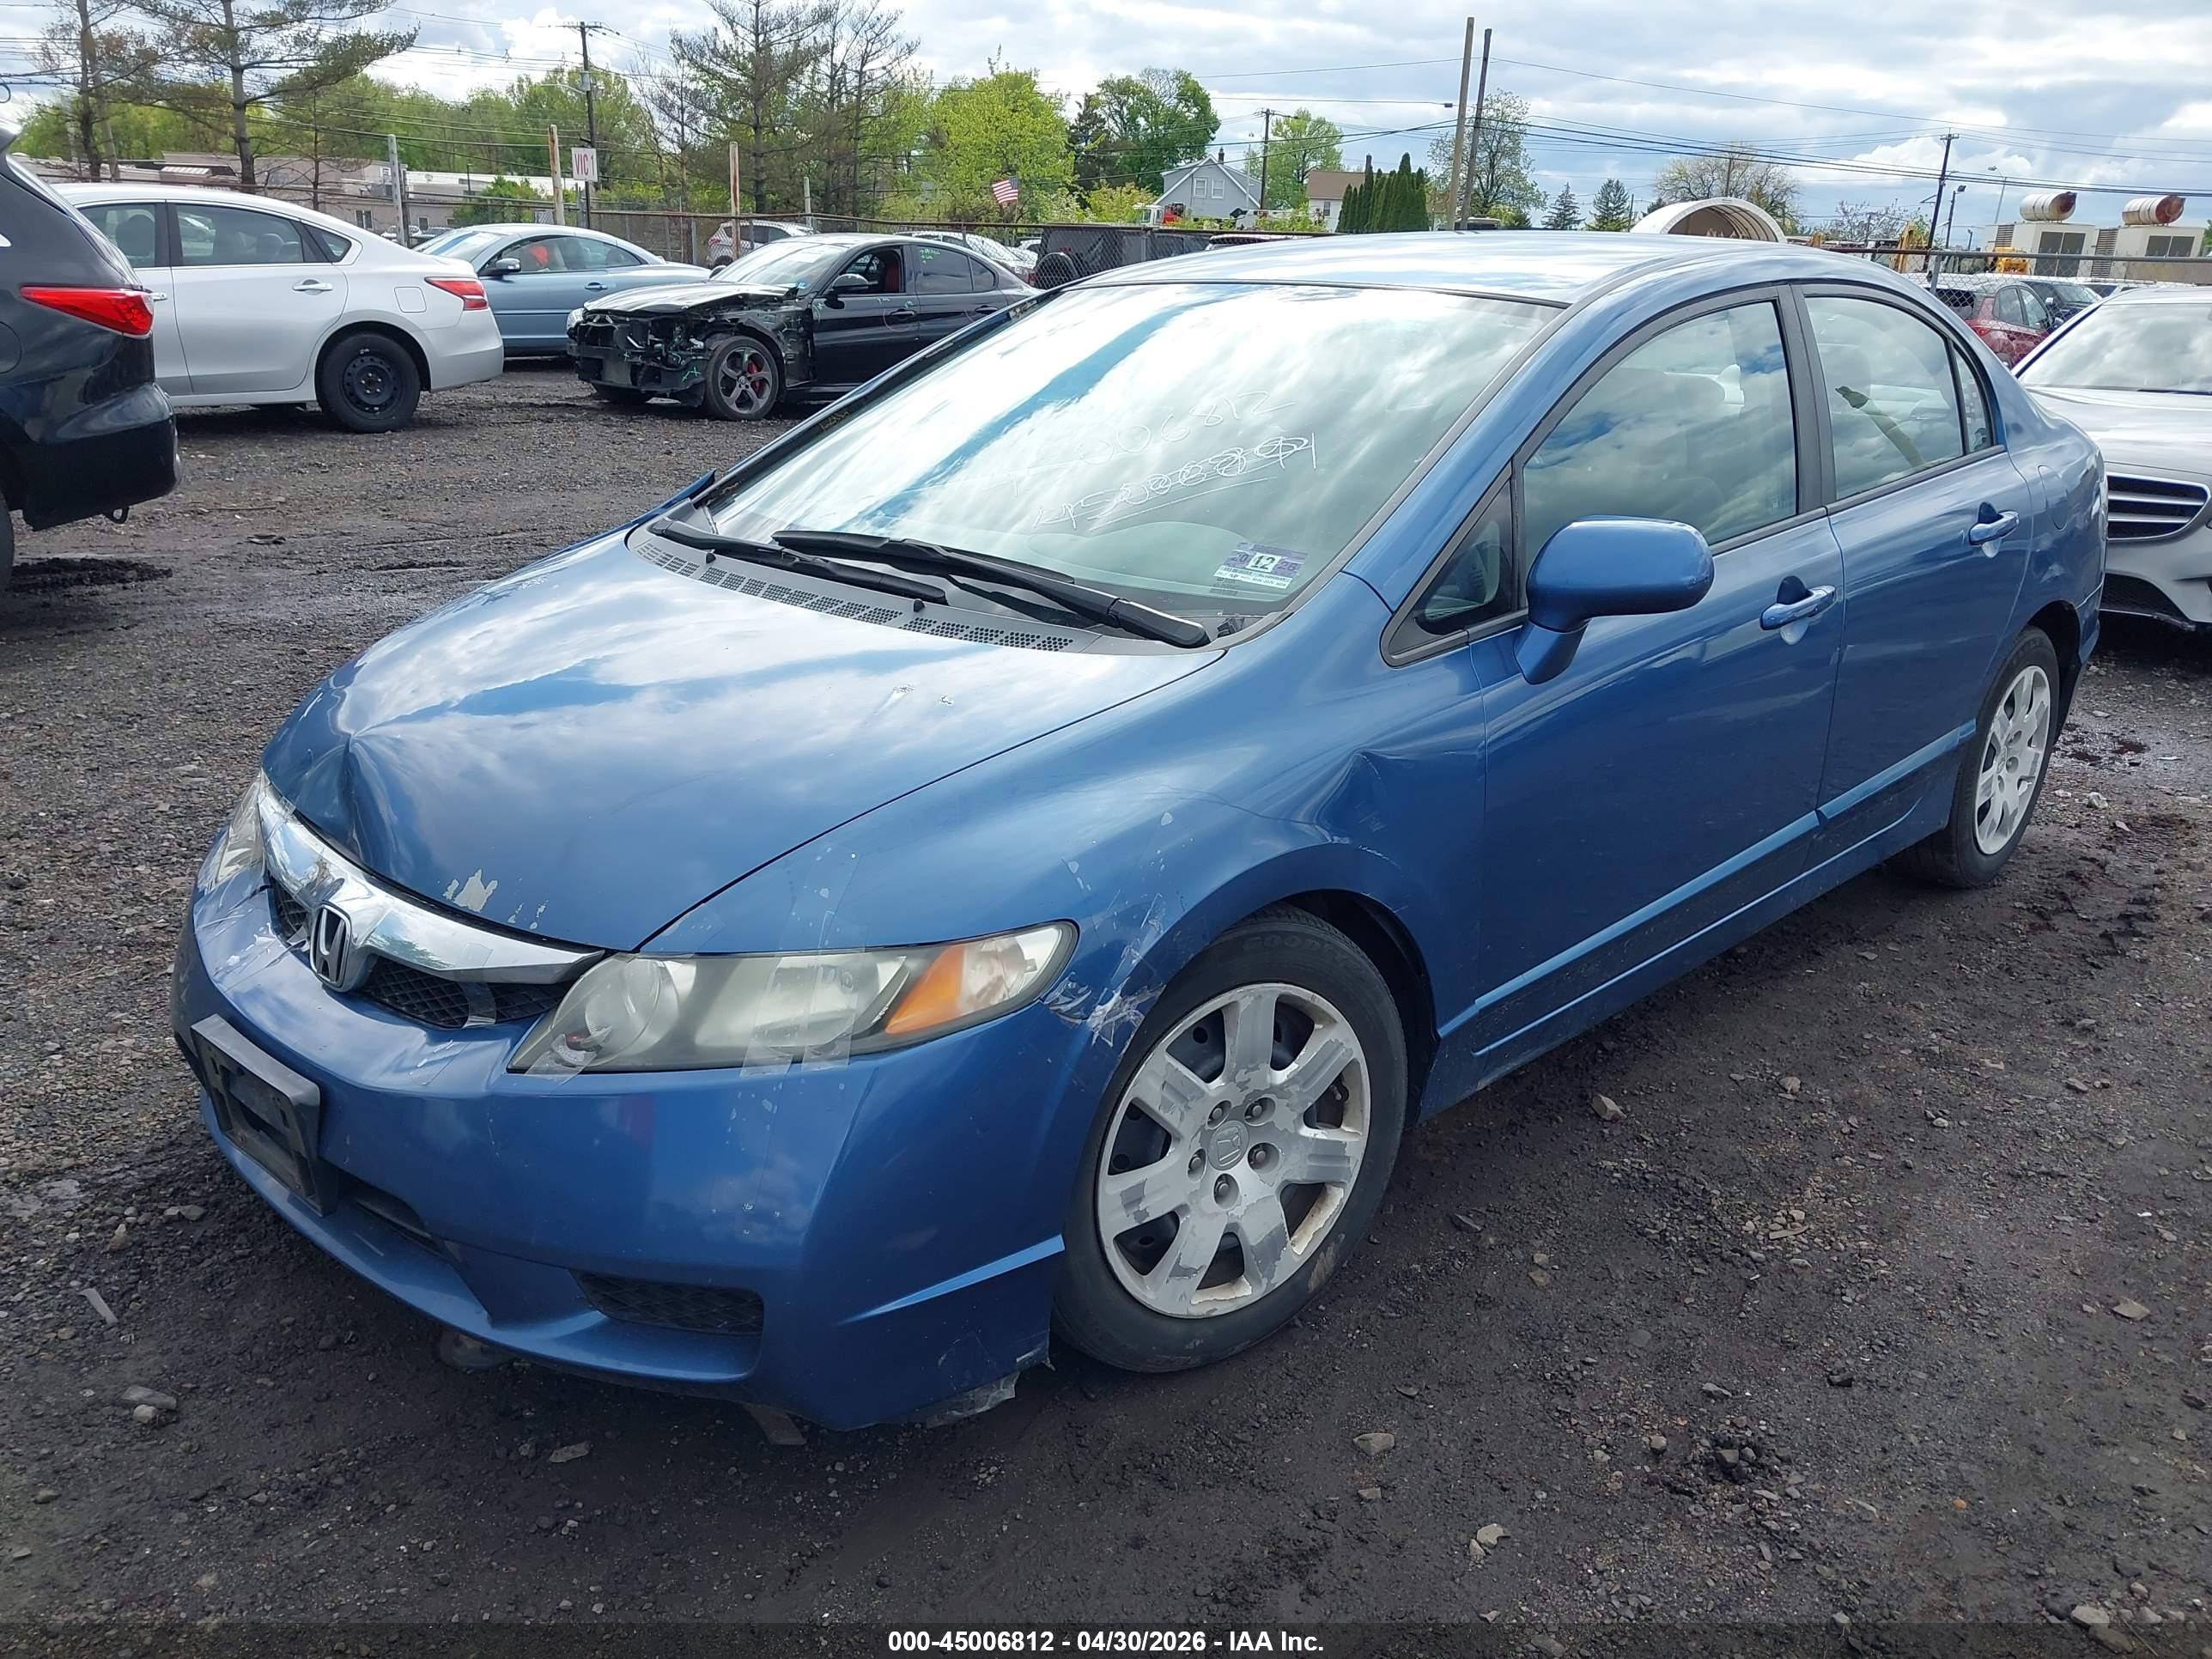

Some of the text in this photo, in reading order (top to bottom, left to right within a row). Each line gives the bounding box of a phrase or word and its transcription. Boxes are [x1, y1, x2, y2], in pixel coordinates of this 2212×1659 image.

[574, 154, 595, 176] VIC 1
[1231, 552, 1249, 563] 20
[1251, 555, 1276, 570] 12
